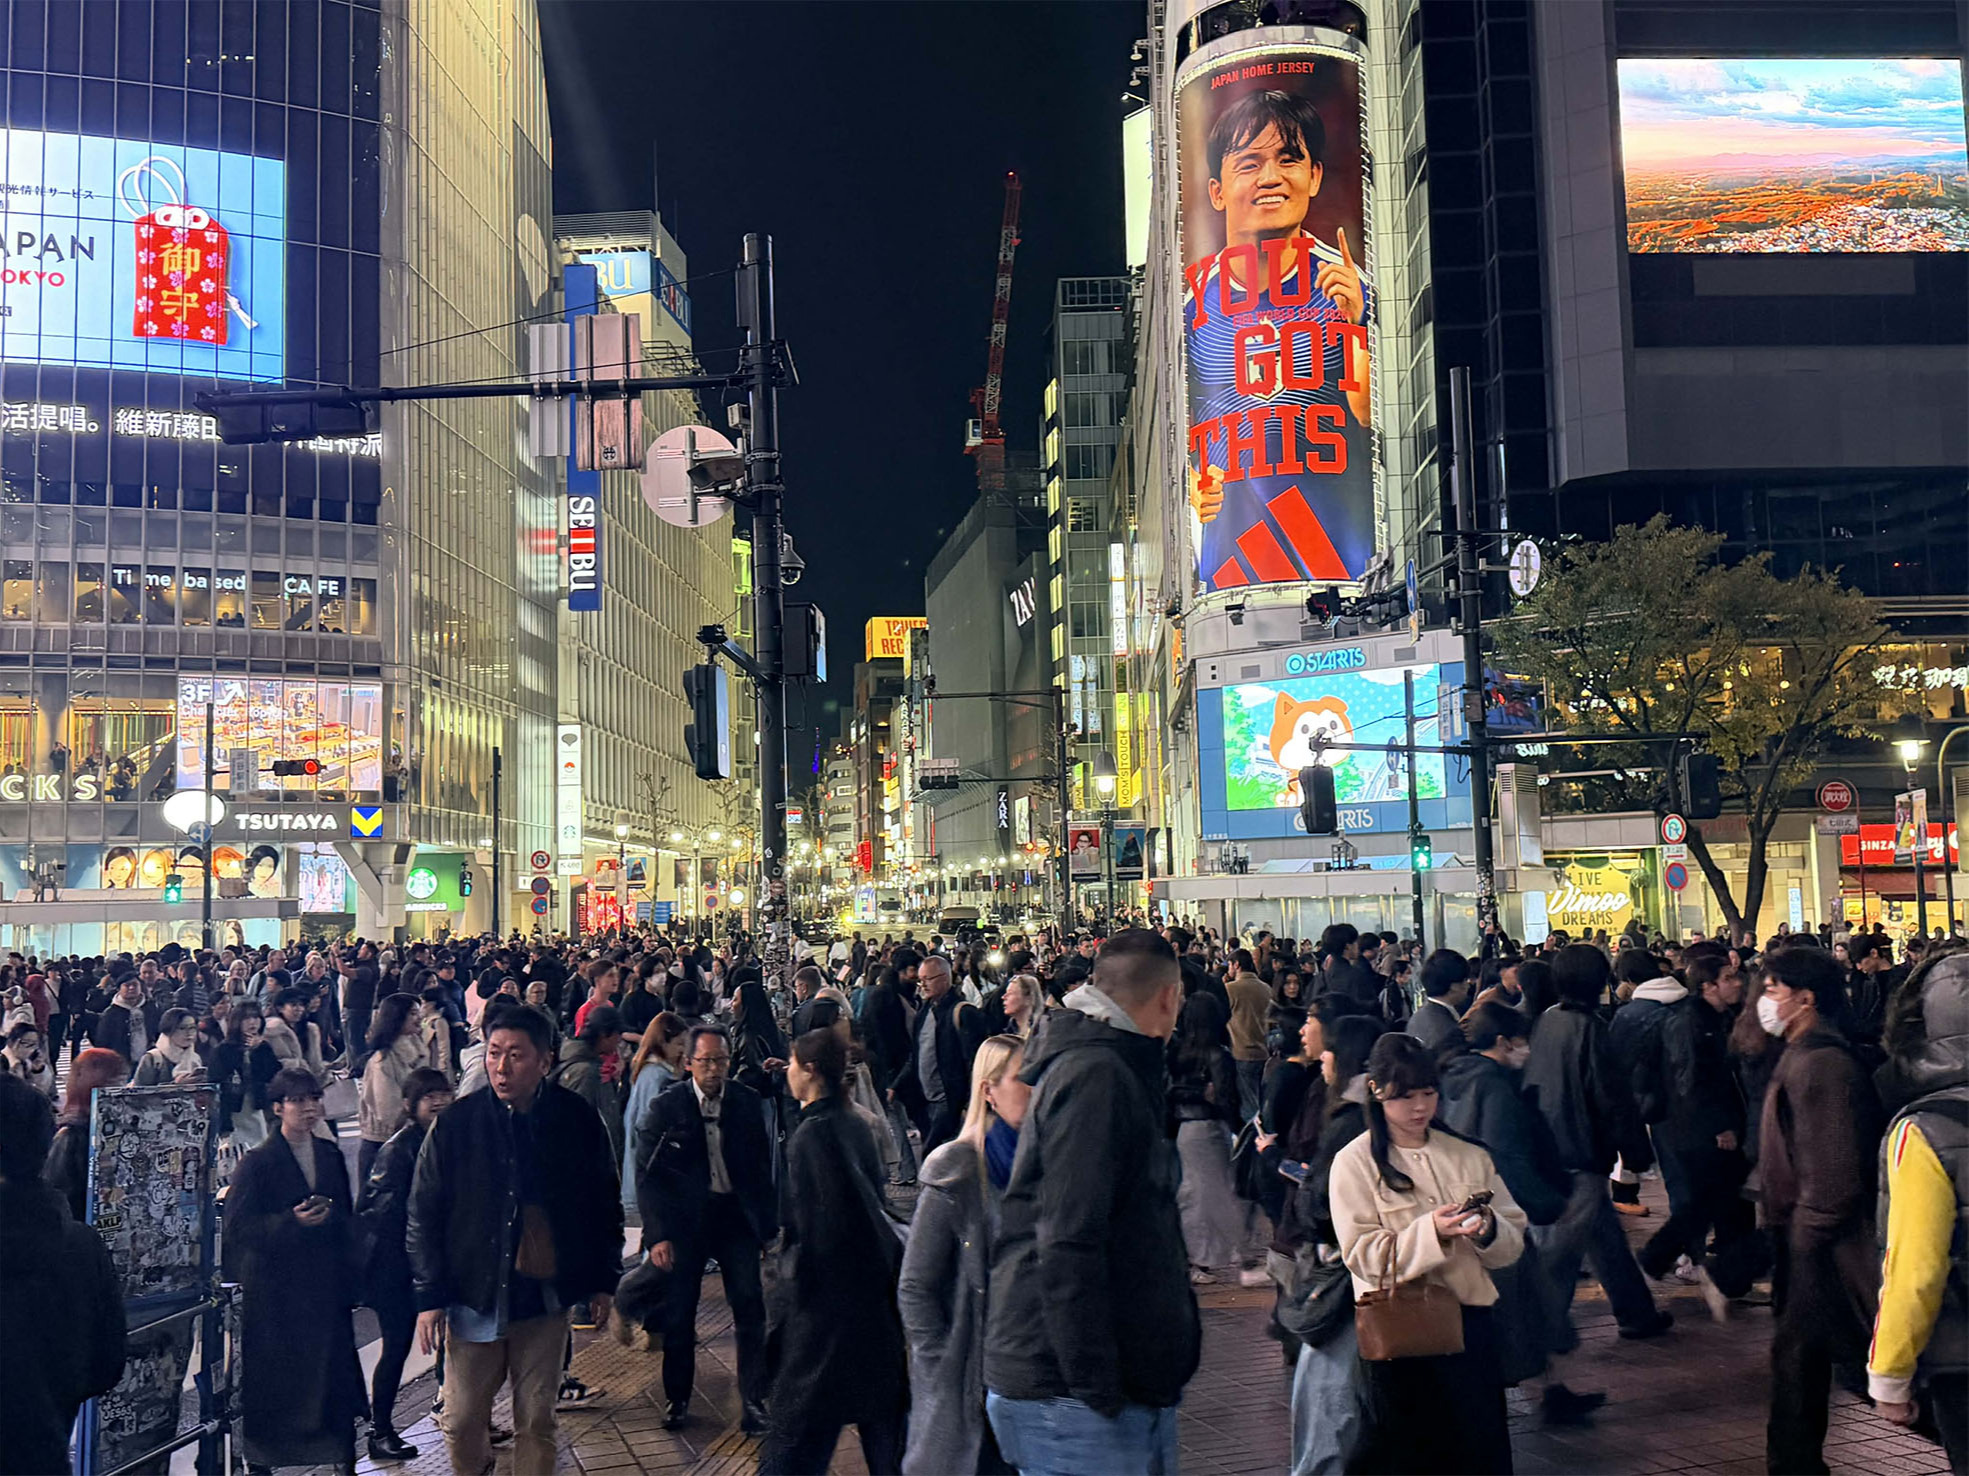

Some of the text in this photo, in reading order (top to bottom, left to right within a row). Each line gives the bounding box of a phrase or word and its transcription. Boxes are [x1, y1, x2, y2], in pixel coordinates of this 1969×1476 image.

[1210, 62, 1315, 90] JAPAN HOME JERSEY
[158, 242, 201, 322] 御守
[1185, 237, 1315, 330] YOU
[1255, 308, 1296, 322] WORLD
[1298, 307, 1321, 319] CUP
[1234, 321, 1368, 396] GOT
[1189, 404, 1348, 490] THIS
[569, 496, 597, 592] SEIBU
[113, 569, 339, 595] Time based CAFE
[181, 684, 211, 703] 3F
[1119, 731, 1129, 767] TOUCH
[0, 774, 97, 800] CKS
[1120, 769, 1130, 806] MOM'S
[235, 813, 338, 830] TSUTAYA
[998, 791, 1009, 828] ZARA
[1562, 911, 1613, 925] DREAMS
